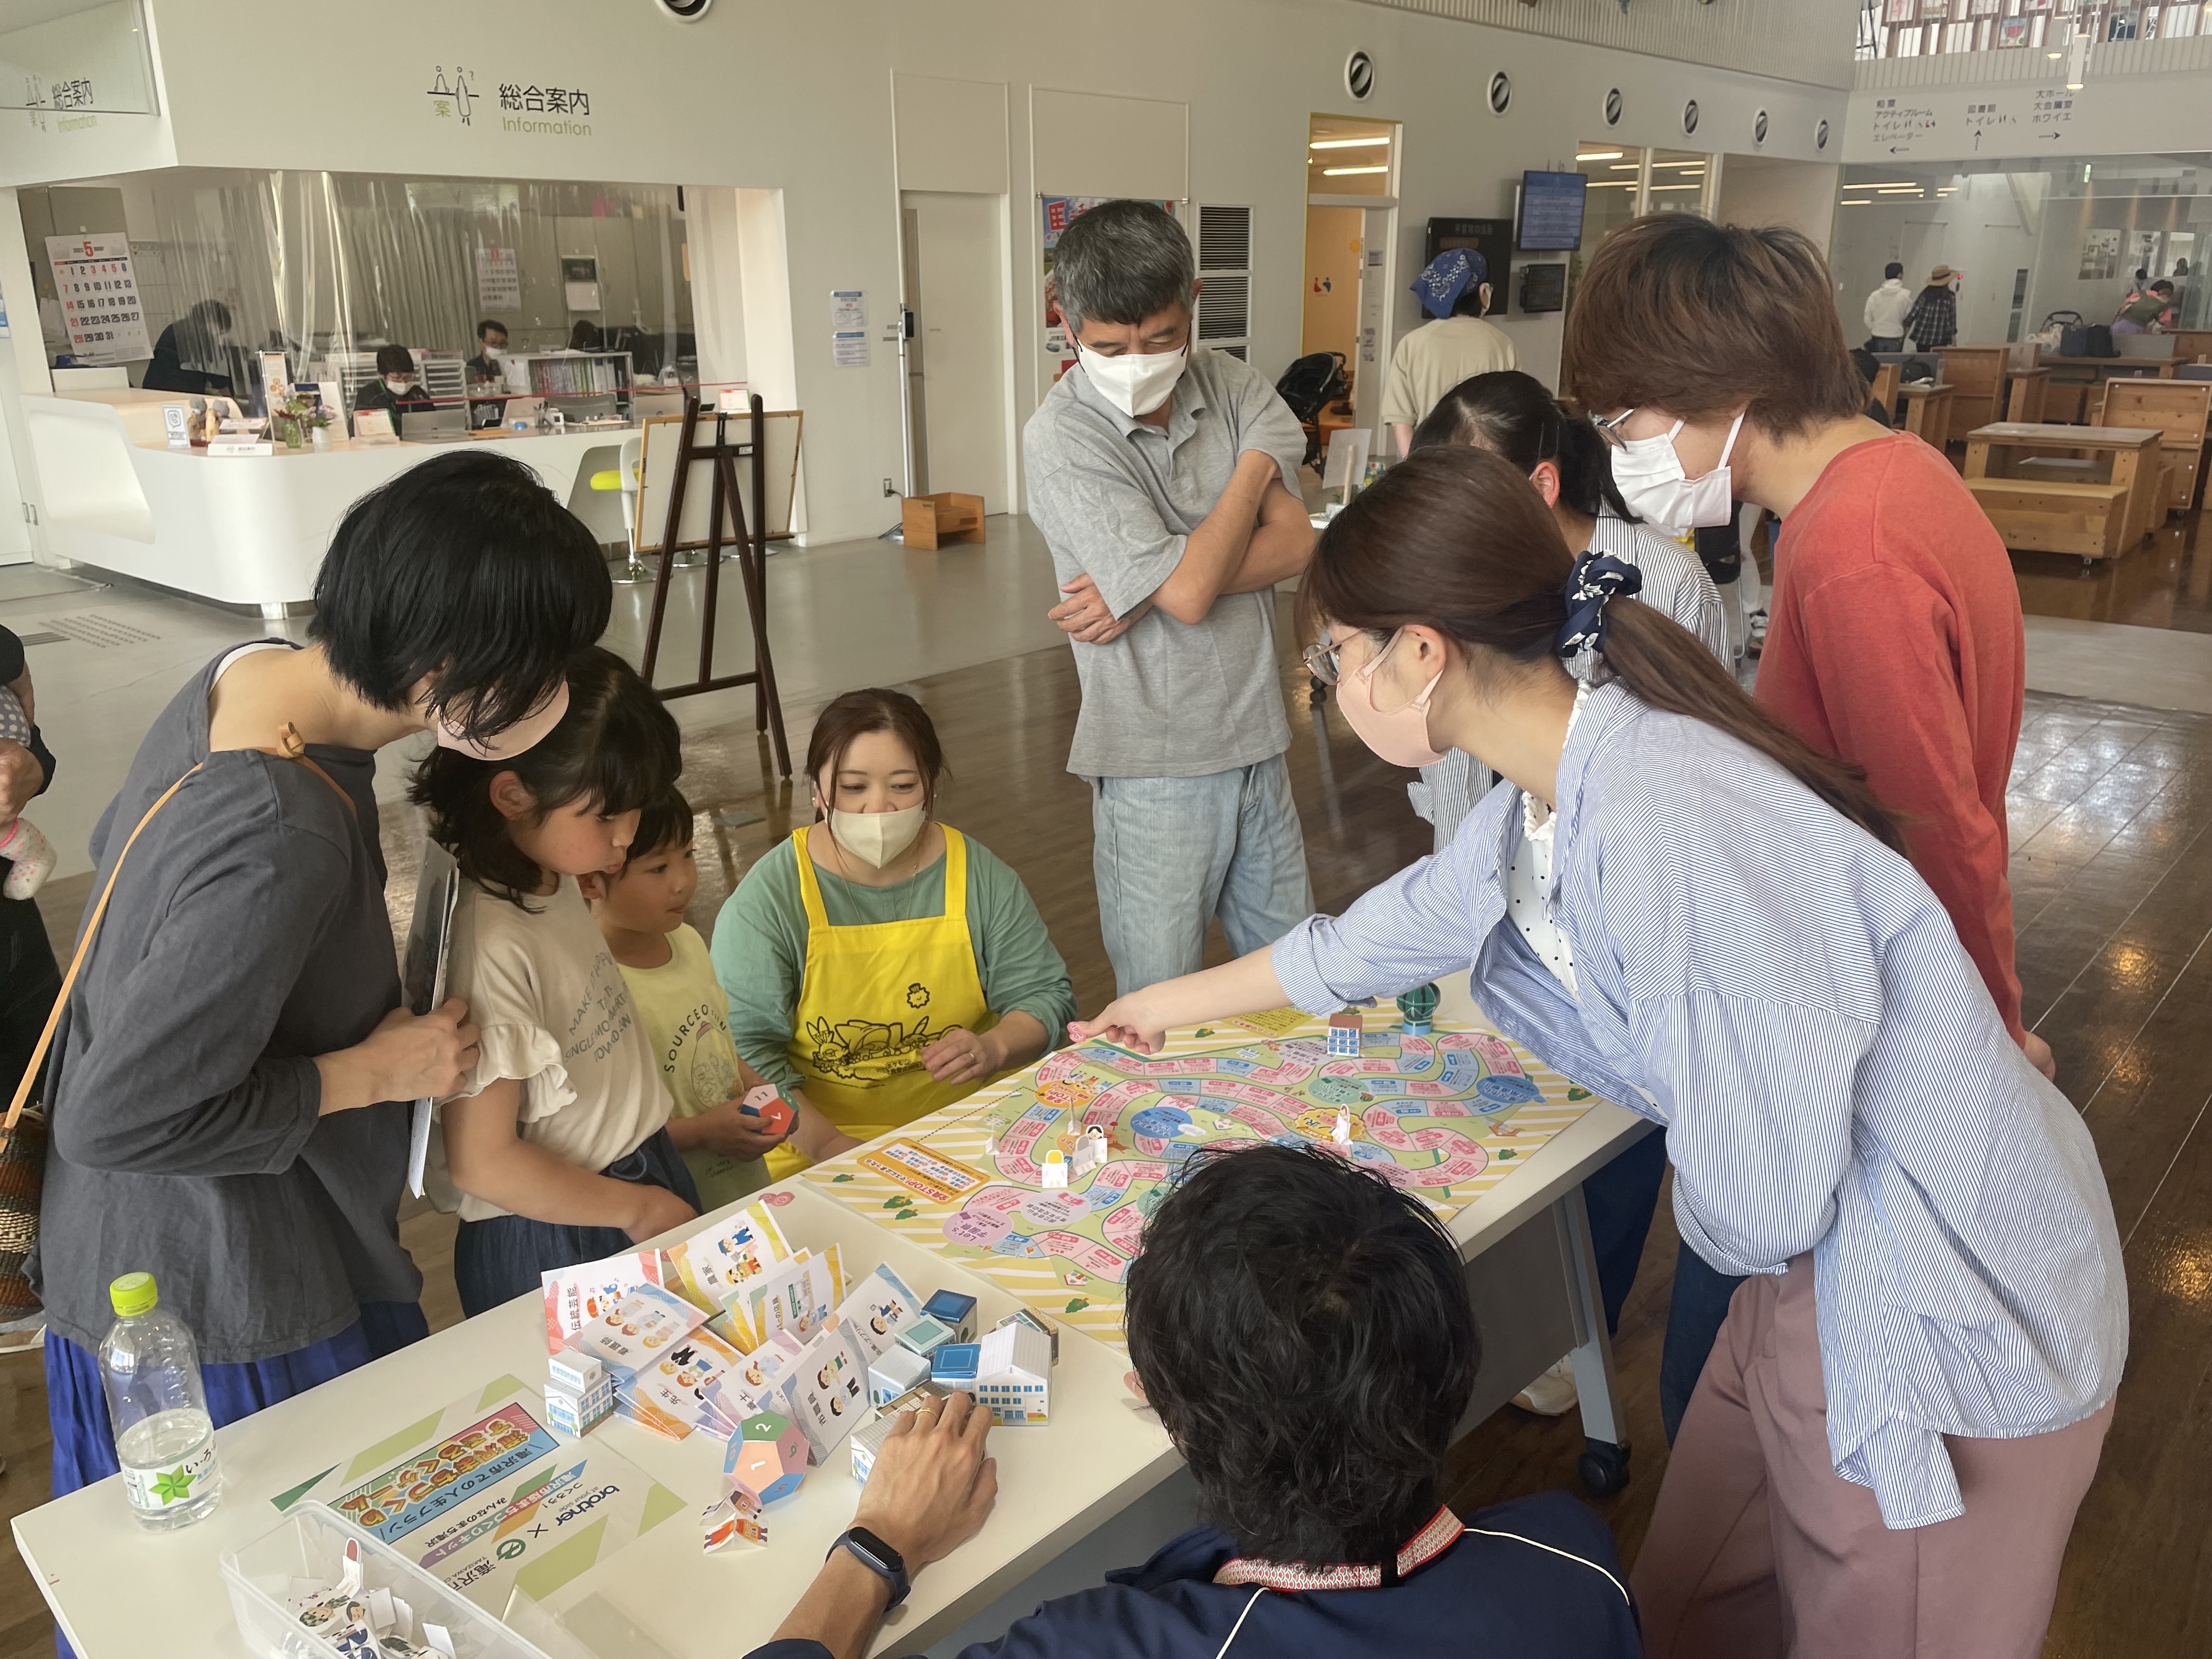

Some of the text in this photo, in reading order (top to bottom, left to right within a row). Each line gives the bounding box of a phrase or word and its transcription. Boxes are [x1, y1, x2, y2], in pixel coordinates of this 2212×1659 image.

[498, 83, 590, 116] 総合案内
[1966, 116, 1996, 127] トイレ
[2032, 112, 2072, 123] ホワイエ
[503, 116, 592, 136] Information
[1872, 121, 1901, 131] トイレ
[82, 241, 94, 257] 5
[70, 266, 75, 275] 1
[80, 266, 86, 275] 2
[90, 265, 96, 274] 3
[101, 264, 107, 273] 4
[63, 284, 69, 293] 7
[74, 283, 80, 292] 8
[84, 283, 91, 291] 9
[93, 281, 101, 291] 10
[104, 281, 112, 290] 11
[114, 280, 122, 289] 12
[66, 301, 75, 310] 14
[76, 300, 85, 309] 15
[98, 298, 105, 307] 17
[117, 296, 126, 306] 19
[70, 318, 79, 327] 21
[80, 317, 91, 326] 22
[90, 315, 101, 325] 23
[100, 315, 110, 324] 24
[131, 312, 139, 321] 27
[94, 332, 104, 341] 30
[105, 331, 114, 340] 31
[754, 1091, 769, 1101] 11
[1049, 1082, 1079, 1095] CHANCE
[865, 1158, 906, 1181] マスに止まったら
[950, 1227, 978, 1242] Let's
[567, 1286, 582, 1331] 伝統芸能
[599, 1336, 629, 1356] 看護師
[659, 1388, 682, 1406] 先生
[755, 1423, 772, 1433] 2
[338, 1418, 514, 1513] すごろくゲーム
[751, 1460, 766, 1471] 1
[358, 1428, 531, 1527] 滝沢まちづくり
[389, 1450, 533, 1533] 滝沢市での人生プラン
[576, 1490, 591, 1503] your
[555, 1485, 620, 1526] brother
[558, 1500, 576, 1512] side
[435, 1471, 577, 1557] 滝沢市版まちづくりキット
[424, 1497, 507, 1548] みんなのまち滝沢
[452, 1556, 488, 1580] TAKIZAWA
